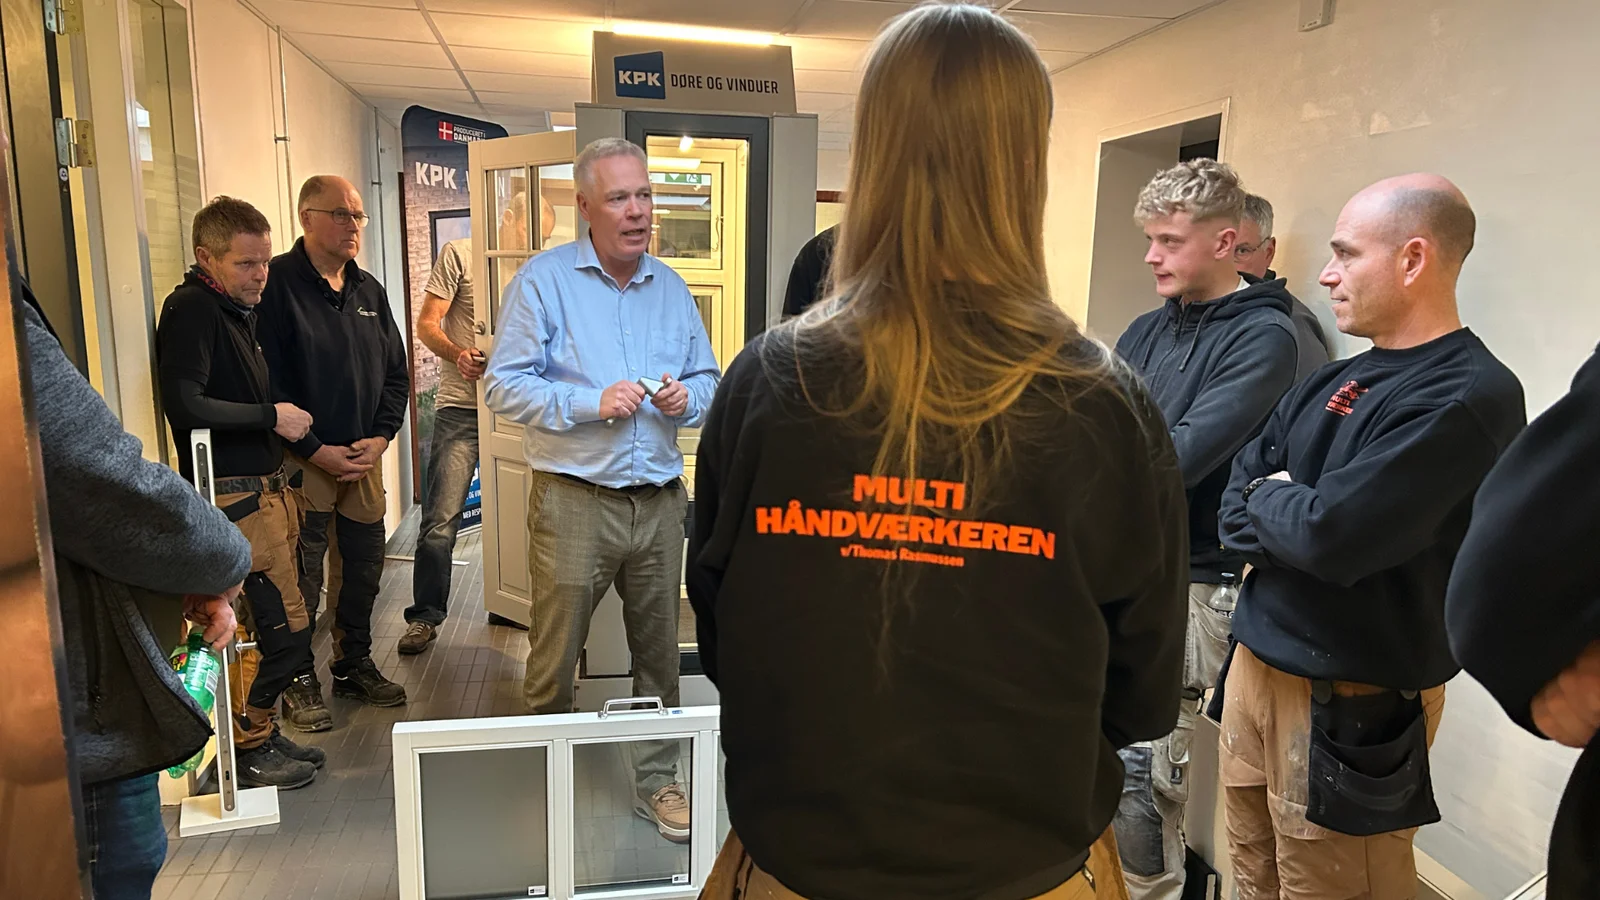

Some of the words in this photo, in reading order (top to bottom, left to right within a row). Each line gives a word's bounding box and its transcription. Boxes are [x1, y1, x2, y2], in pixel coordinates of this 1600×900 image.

[618, 70, 661, 87] KPK
[671, 74, 702, 89] DØRE
[706, 76, 723, 91] OG
[726, 78, 779, 94] VINDUER
[453, 126, 483, 138] PRODUCERET
[415, 161, 457, 190] KPK
[853, 474, 966, 510] MULTI
[755, 499, 1056, 559] HÅNDVÆRKEREN
[899, 547, 965, 567] Rasmussen
